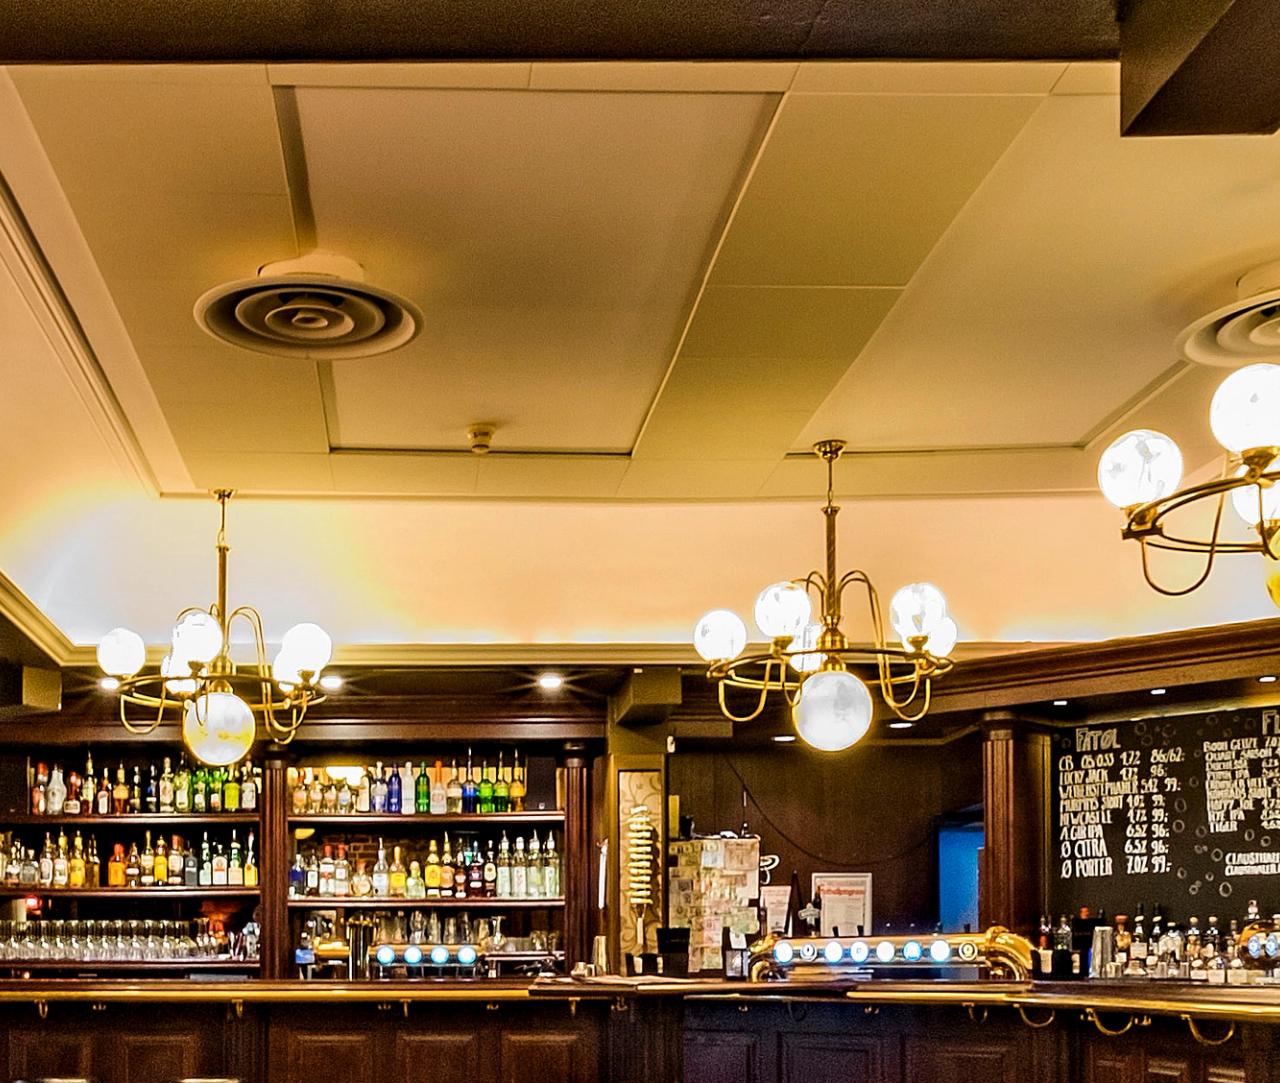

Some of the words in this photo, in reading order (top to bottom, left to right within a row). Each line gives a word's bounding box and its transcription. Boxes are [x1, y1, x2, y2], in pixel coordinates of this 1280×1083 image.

[1075, 728, 1121, 752] FATØL
[1060, 841, 1071, 859] Ø
[1074, 838, 1109, 859] CITRA
[1060, 859, 1072, 879] Ø
[1074, 856, 1113, 879] PORTER
